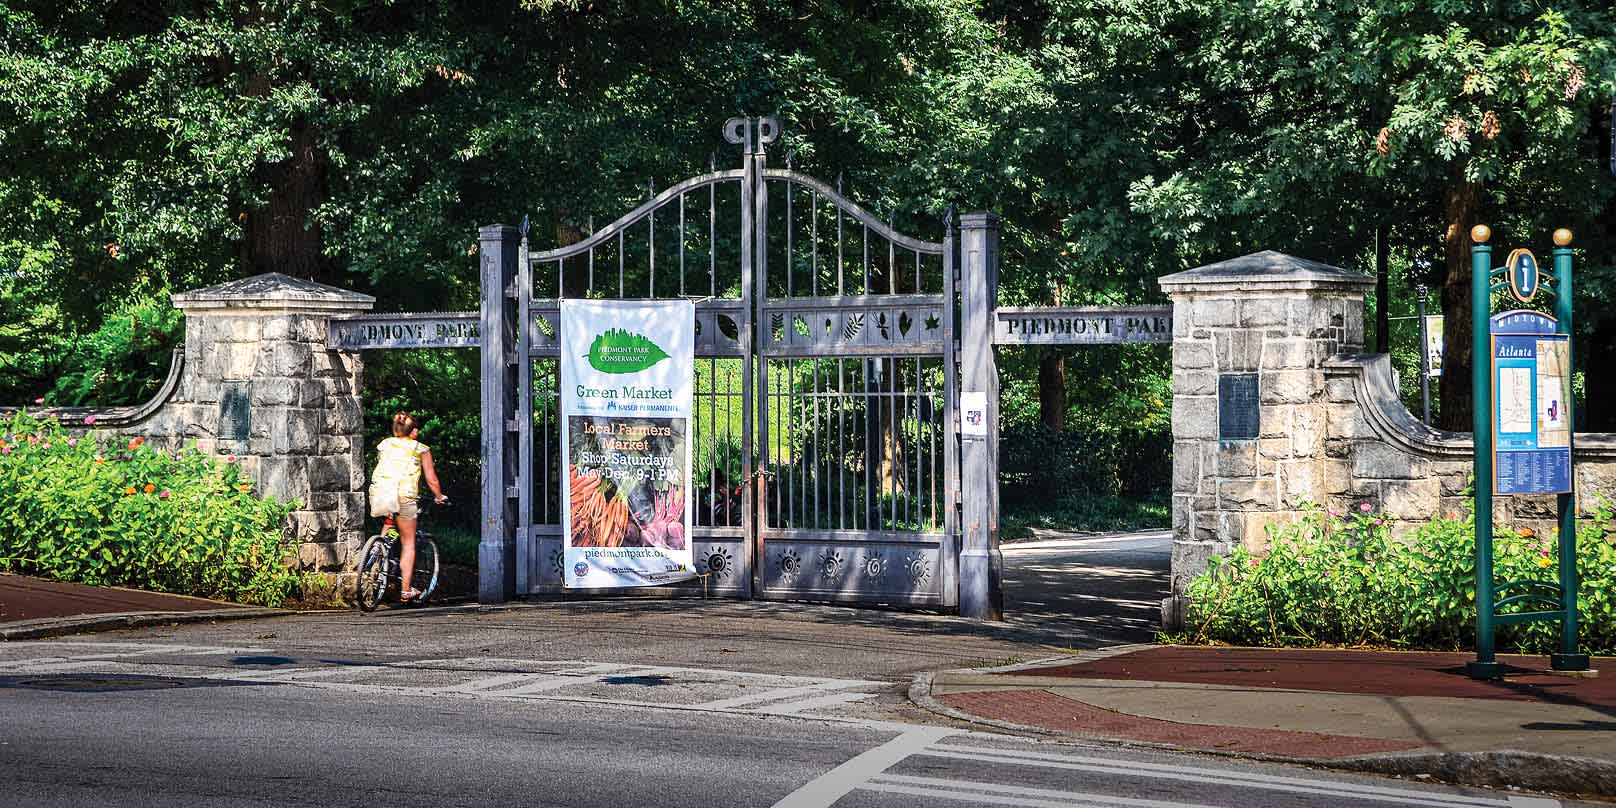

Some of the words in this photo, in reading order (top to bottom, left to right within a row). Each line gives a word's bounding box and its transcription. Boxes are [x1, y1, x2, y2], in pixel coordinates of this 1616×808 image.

[1007, 317, 1113, 334] PIEDMONT
[1498, 314, 1553, 329] MIDTOWN
[1499, 345, 1532, 357] Atlanta
[576, 384, 618, 399] Green
[622, 386, 673, 400] Market
[618, 404, 638, 412] KAISER
[583, 422, 615, 434] Local
[618, 424, 672, 436] Farmers
[602, 438, 649, 451] Market
[582, 452, 608, 467] Shop
[612, 453, 674, 468] Saturdays
[636, 469, 656, 480] 9-1
[658, 469, 679, 480] PM
